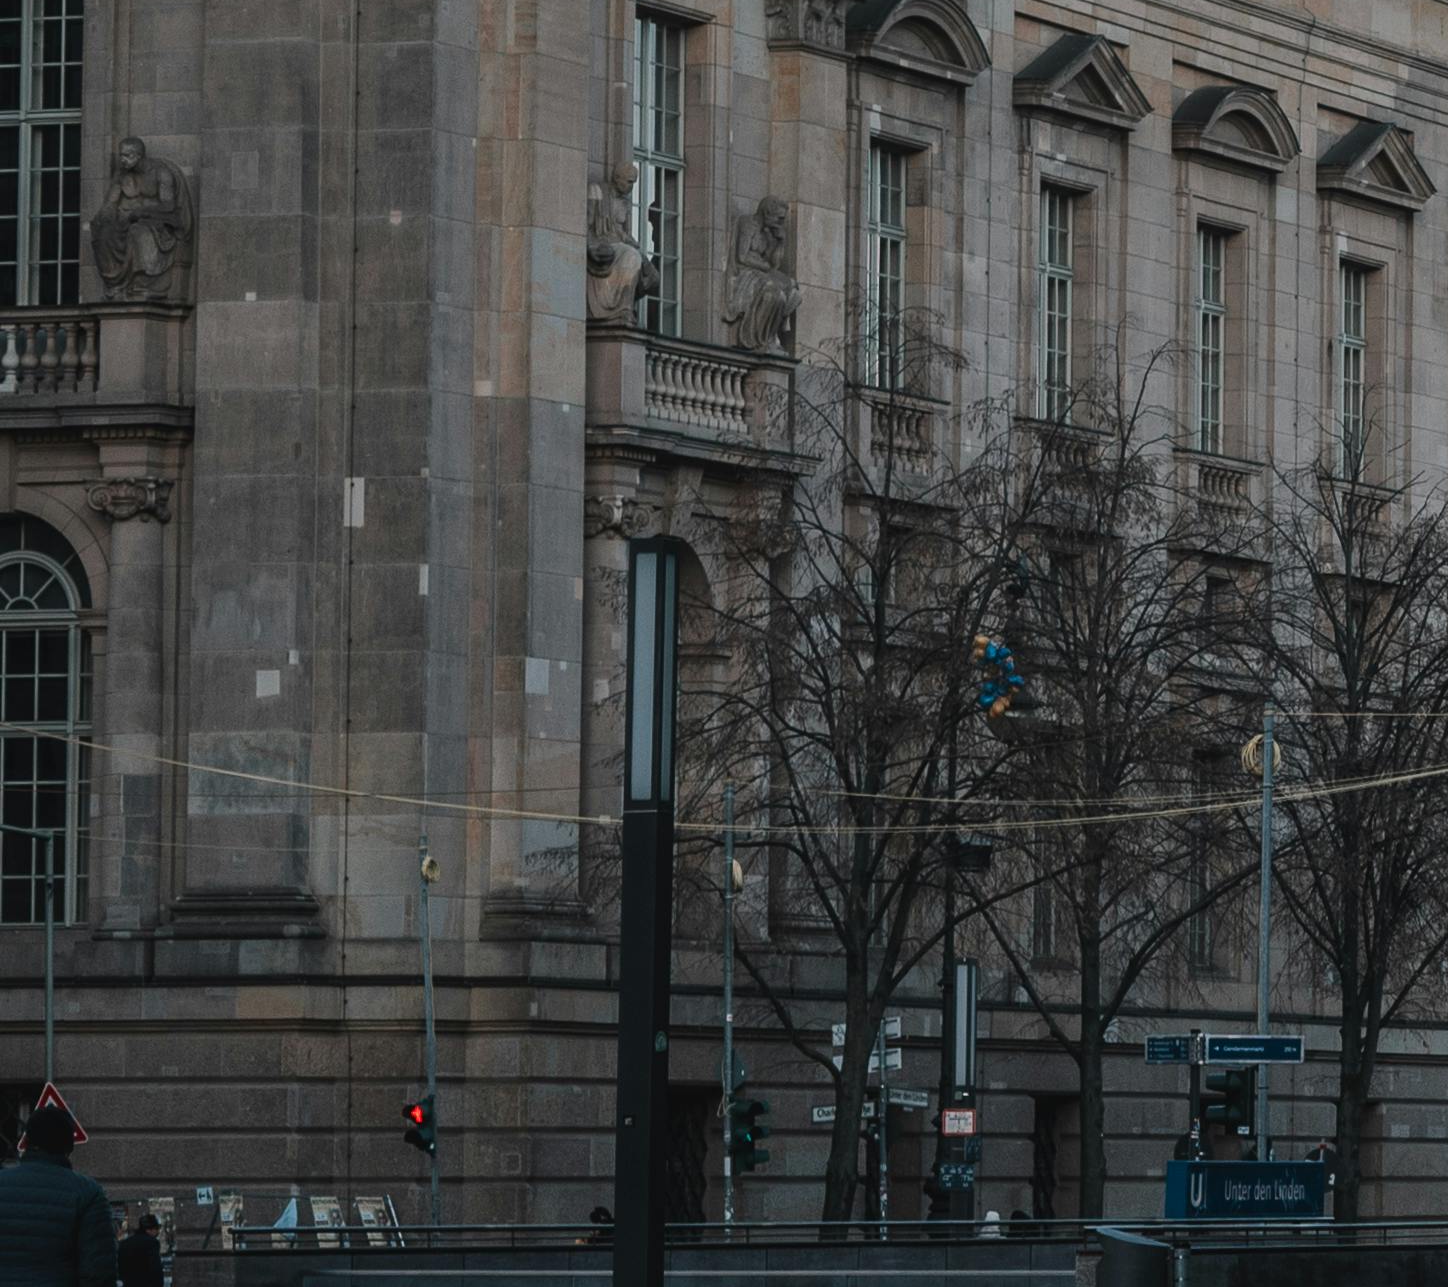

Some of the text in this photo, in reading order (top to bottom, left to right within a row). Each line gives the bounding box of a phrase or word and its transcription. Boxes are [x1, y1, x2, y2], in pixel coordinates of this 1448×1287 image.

[1190, 1172, 1305, 1208] U Unter den Linden
